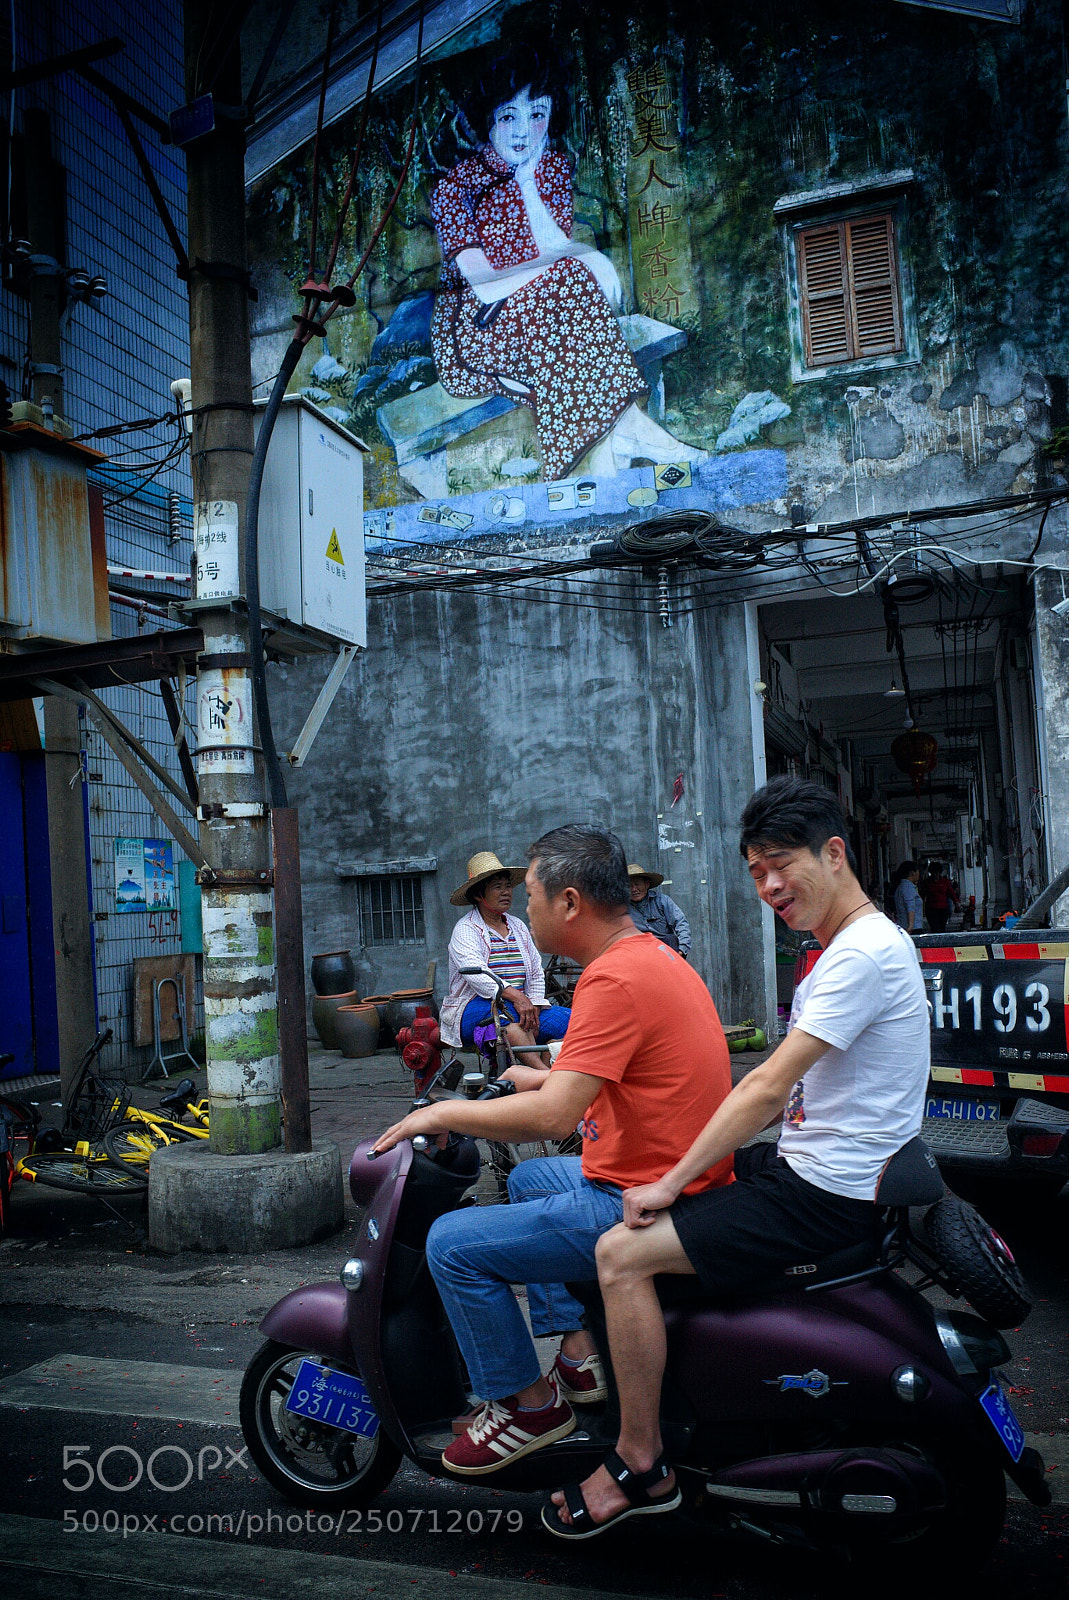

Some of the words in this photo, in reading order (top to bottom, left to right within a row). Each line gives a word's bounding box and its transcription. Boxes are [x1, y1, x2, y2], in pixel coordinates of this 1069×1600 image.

[625, 62, 689, 320] 雙美人牌香粉
[311, 1376, 328, 1392] 海
[294, 1389, 377, 1432] 931137
